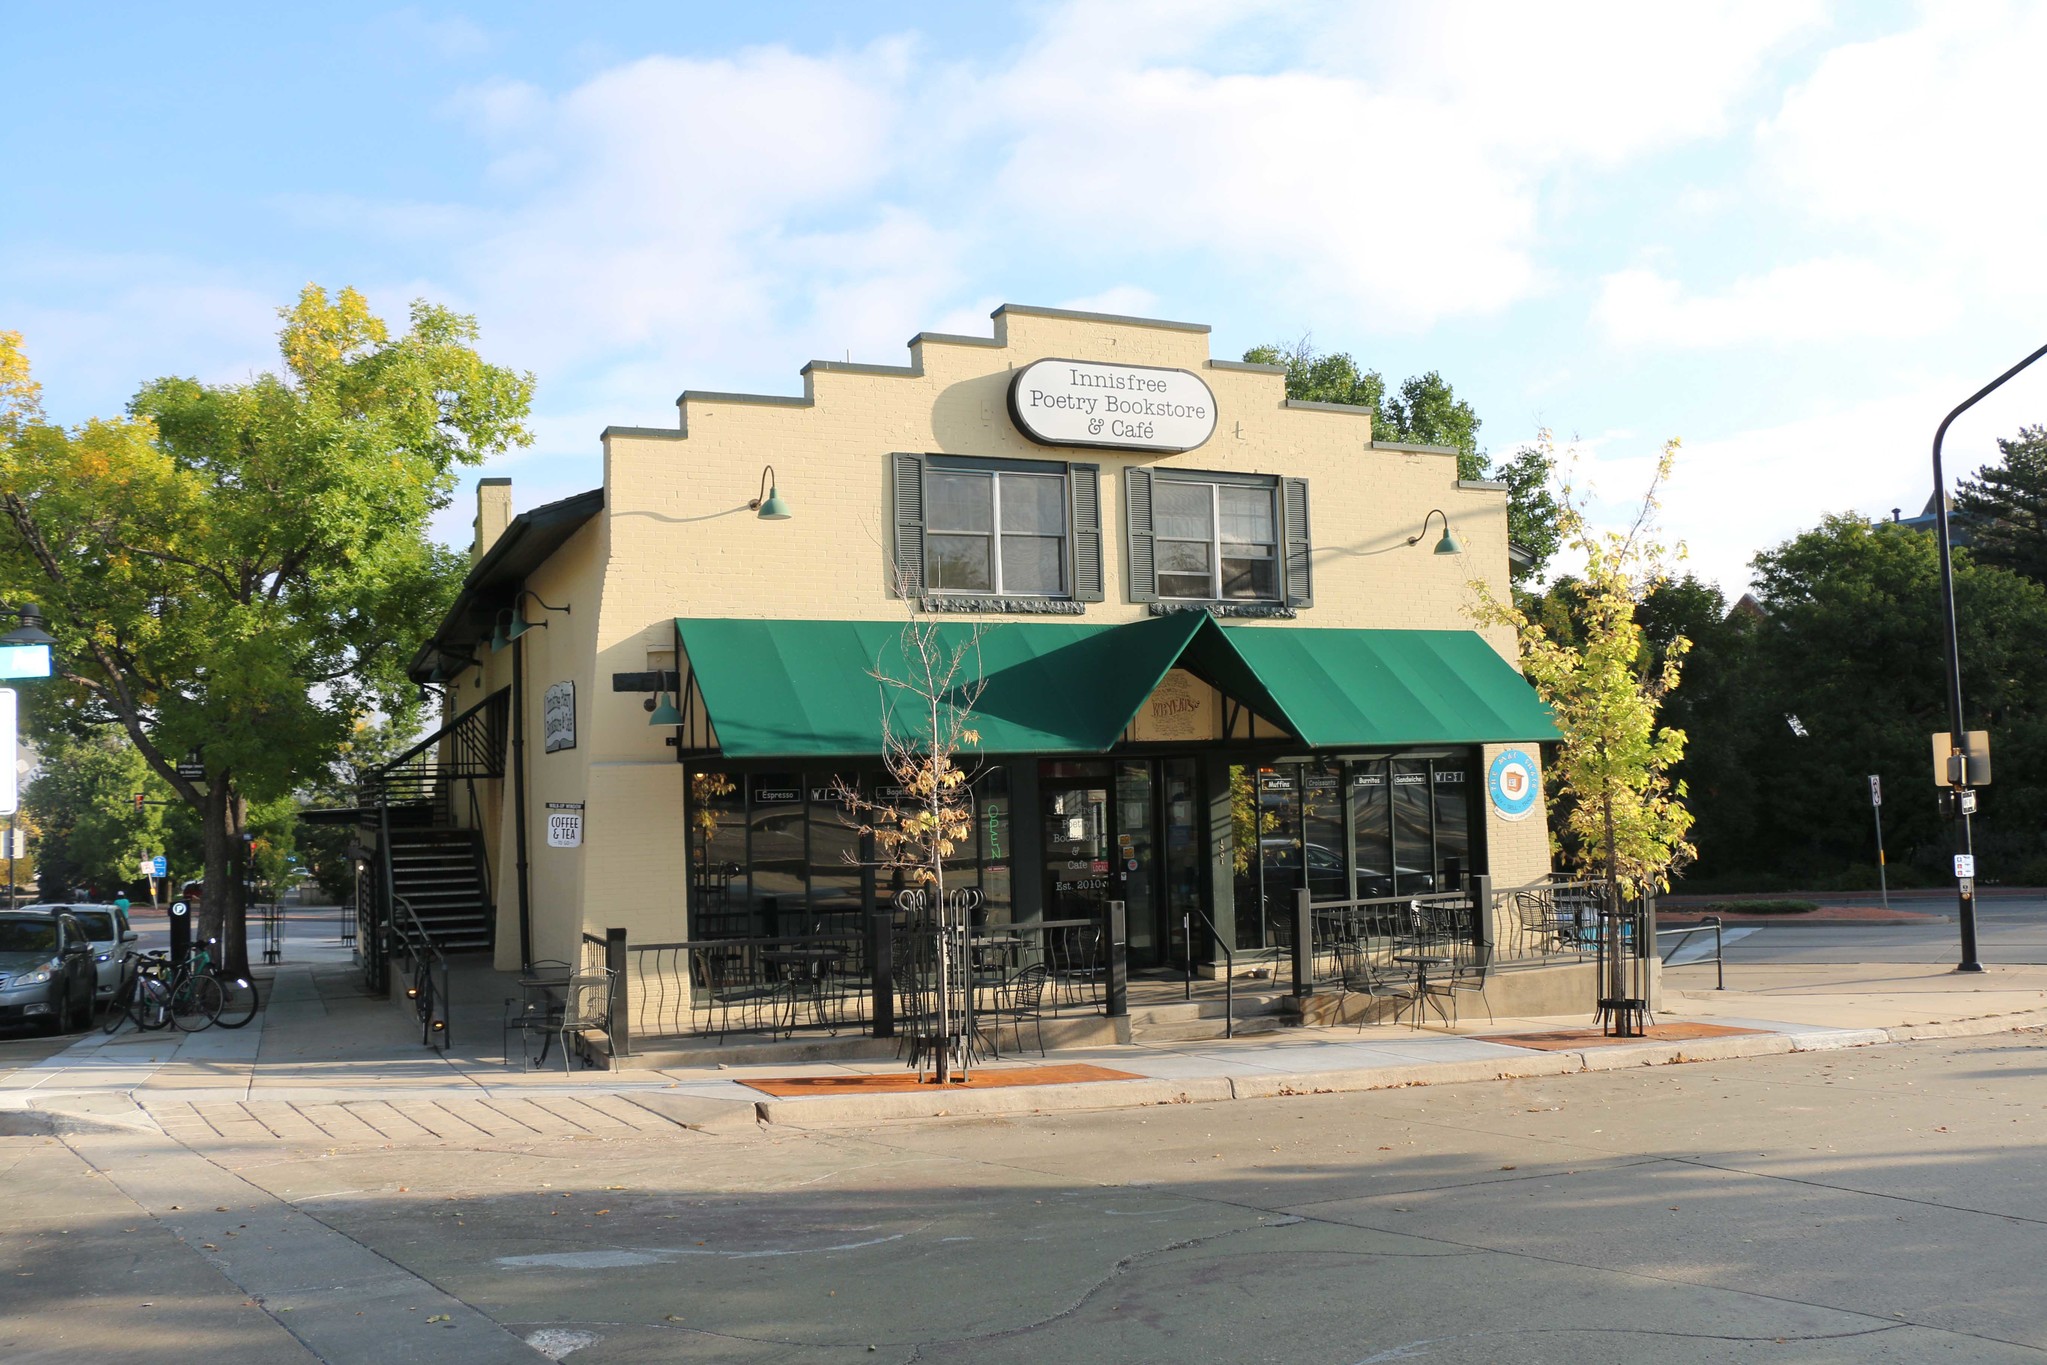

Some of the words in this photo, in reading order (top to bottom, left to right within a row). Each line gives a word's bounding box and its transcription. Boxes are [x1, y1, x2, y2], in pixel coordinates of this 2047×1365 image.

[1070, 369, 1167, 393] Innisfree
[1030, 390, 1098, 415] Poetry
[1105, 395, 1206, 419] Bookstore
[1088, 418, 1105, 436] &
[1112, 420, 1154, 439] Café
[1308, 779, 1336, 787] Croissants
[762, 790, 794, 800] Espresso
[551, 816, 579, 829] COFFEE
[553, 828, 559, 840] &
[562, 828, 576, 840] TEA
[988, 804, 1001, 860] OPEN
[1056, 881, 1075, 891] Est.
[1077, 880, 1101, 889] 2010
